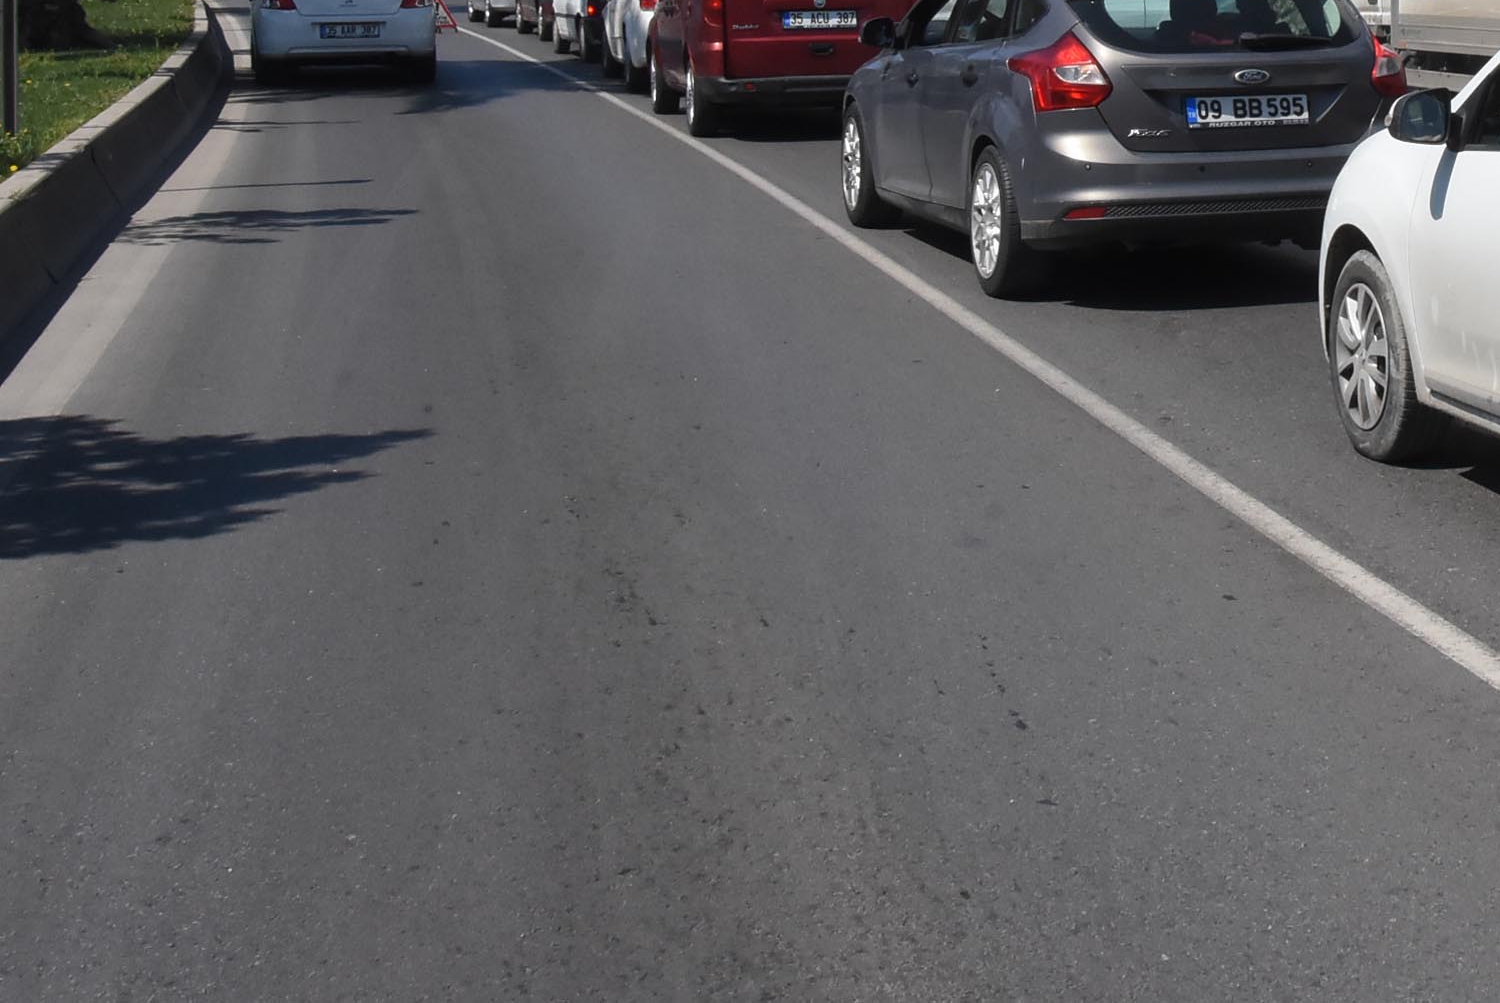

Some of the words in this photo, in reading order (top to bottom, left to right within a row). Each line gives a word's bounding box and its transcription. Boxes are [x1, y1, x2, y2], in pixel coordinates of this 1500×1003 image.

[791, 13, 803, 24] 35
[837, 12, 855, 24] 387
[1197, 100, 1222, 120] 09
[1233, 98, 1263, 118] BB
[1267, 97, 1305, 117] 595
